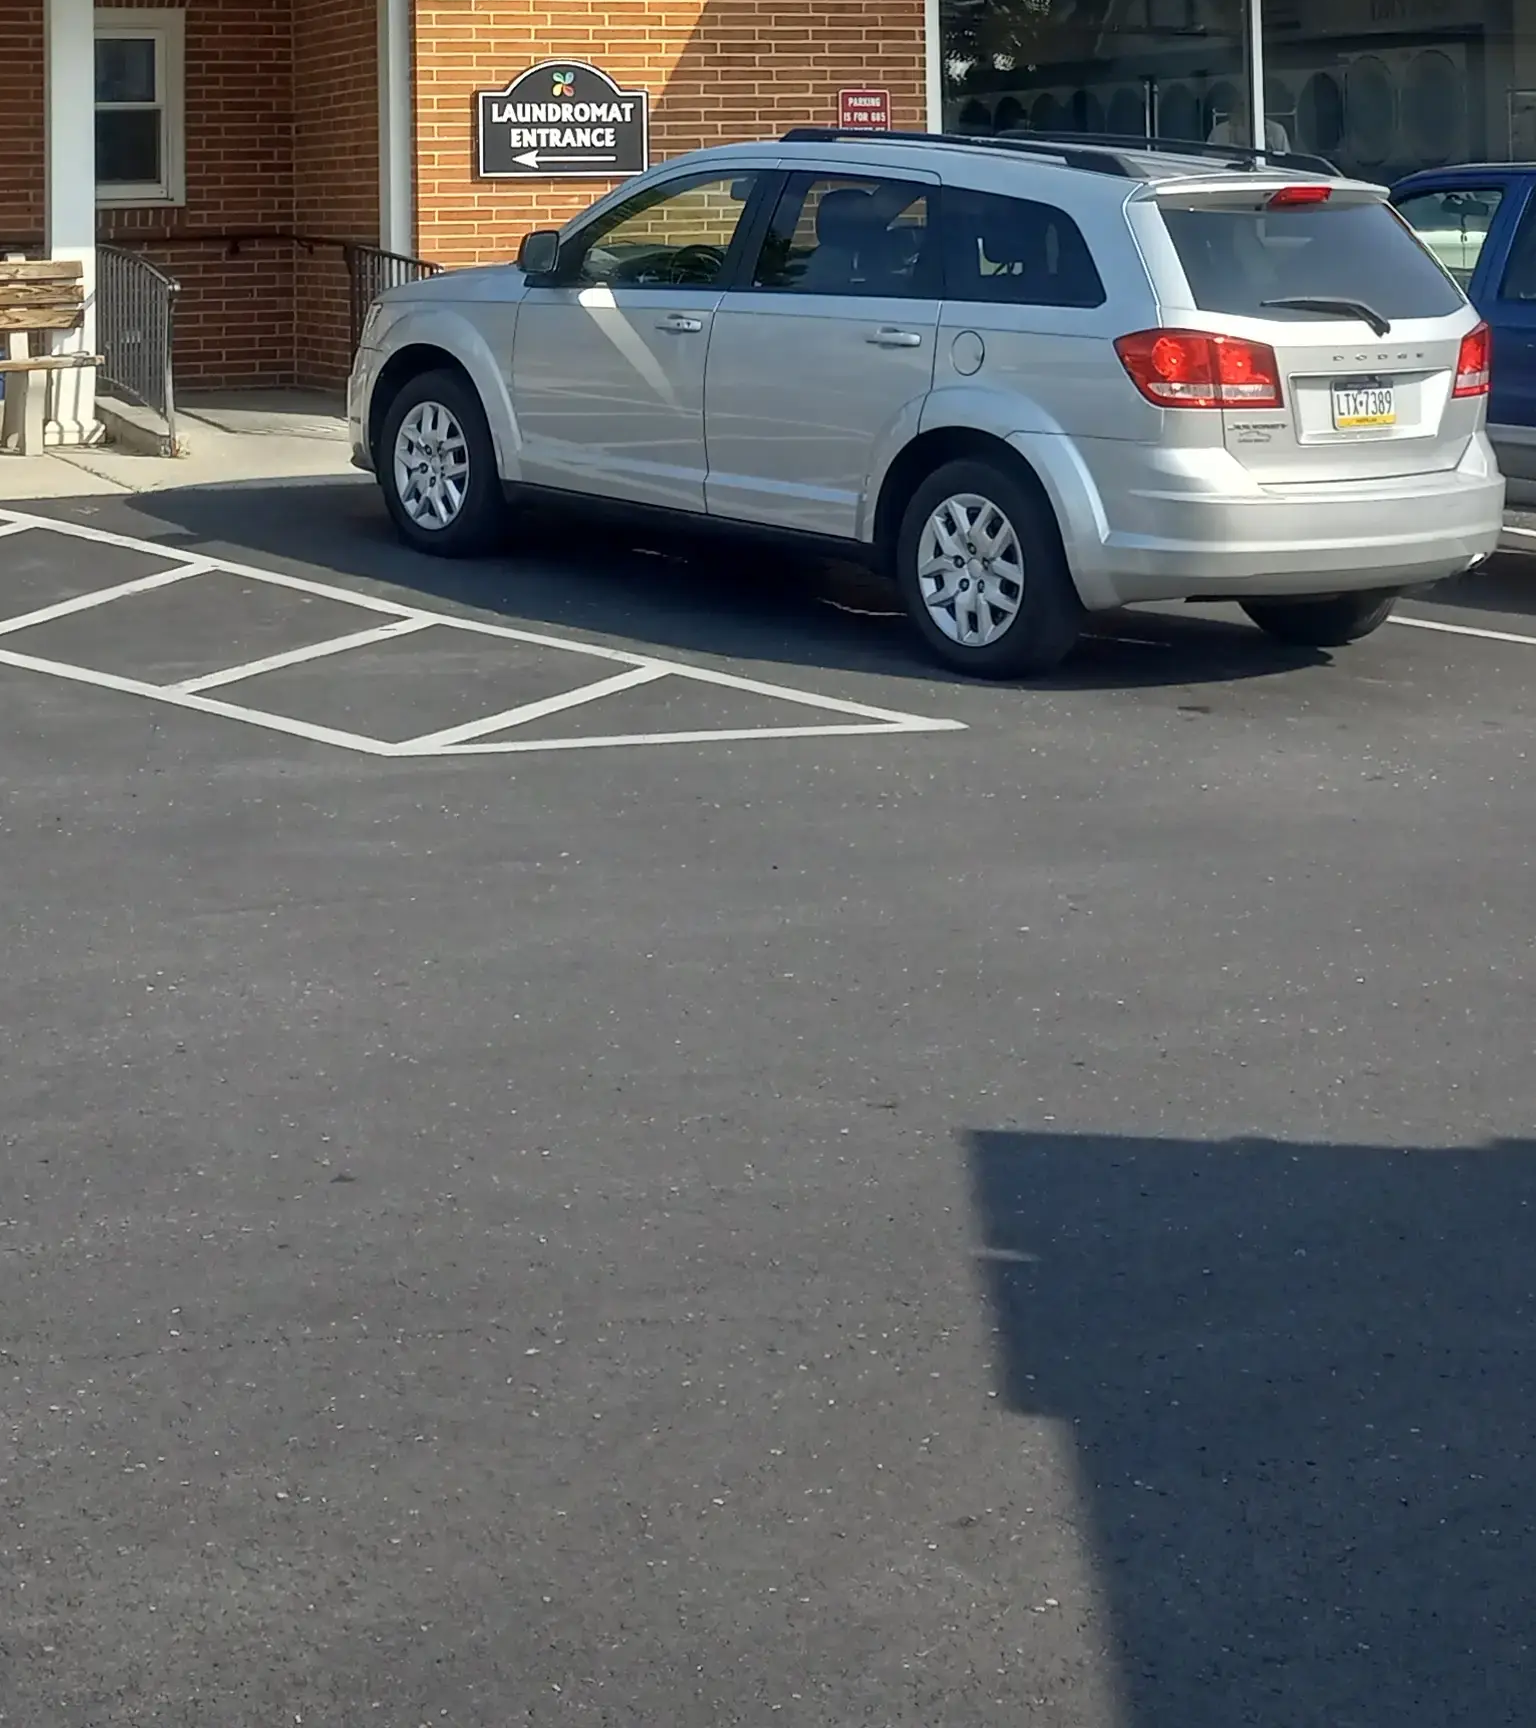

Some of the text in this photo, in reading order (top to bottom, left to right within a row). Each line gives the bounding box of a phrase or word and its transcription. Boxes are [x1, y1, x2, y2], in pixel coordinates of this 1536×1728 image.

[848, 97, 881, 107] PARKING
[491, 102, 635, 123] LAUNDROMAT
[844, 112, 852, 122] IS
[853, 112, 869, 122] FOR
[510, 127, 617, 148] ENTRANCE
[1332, 353, 1424, 362] DODGE
